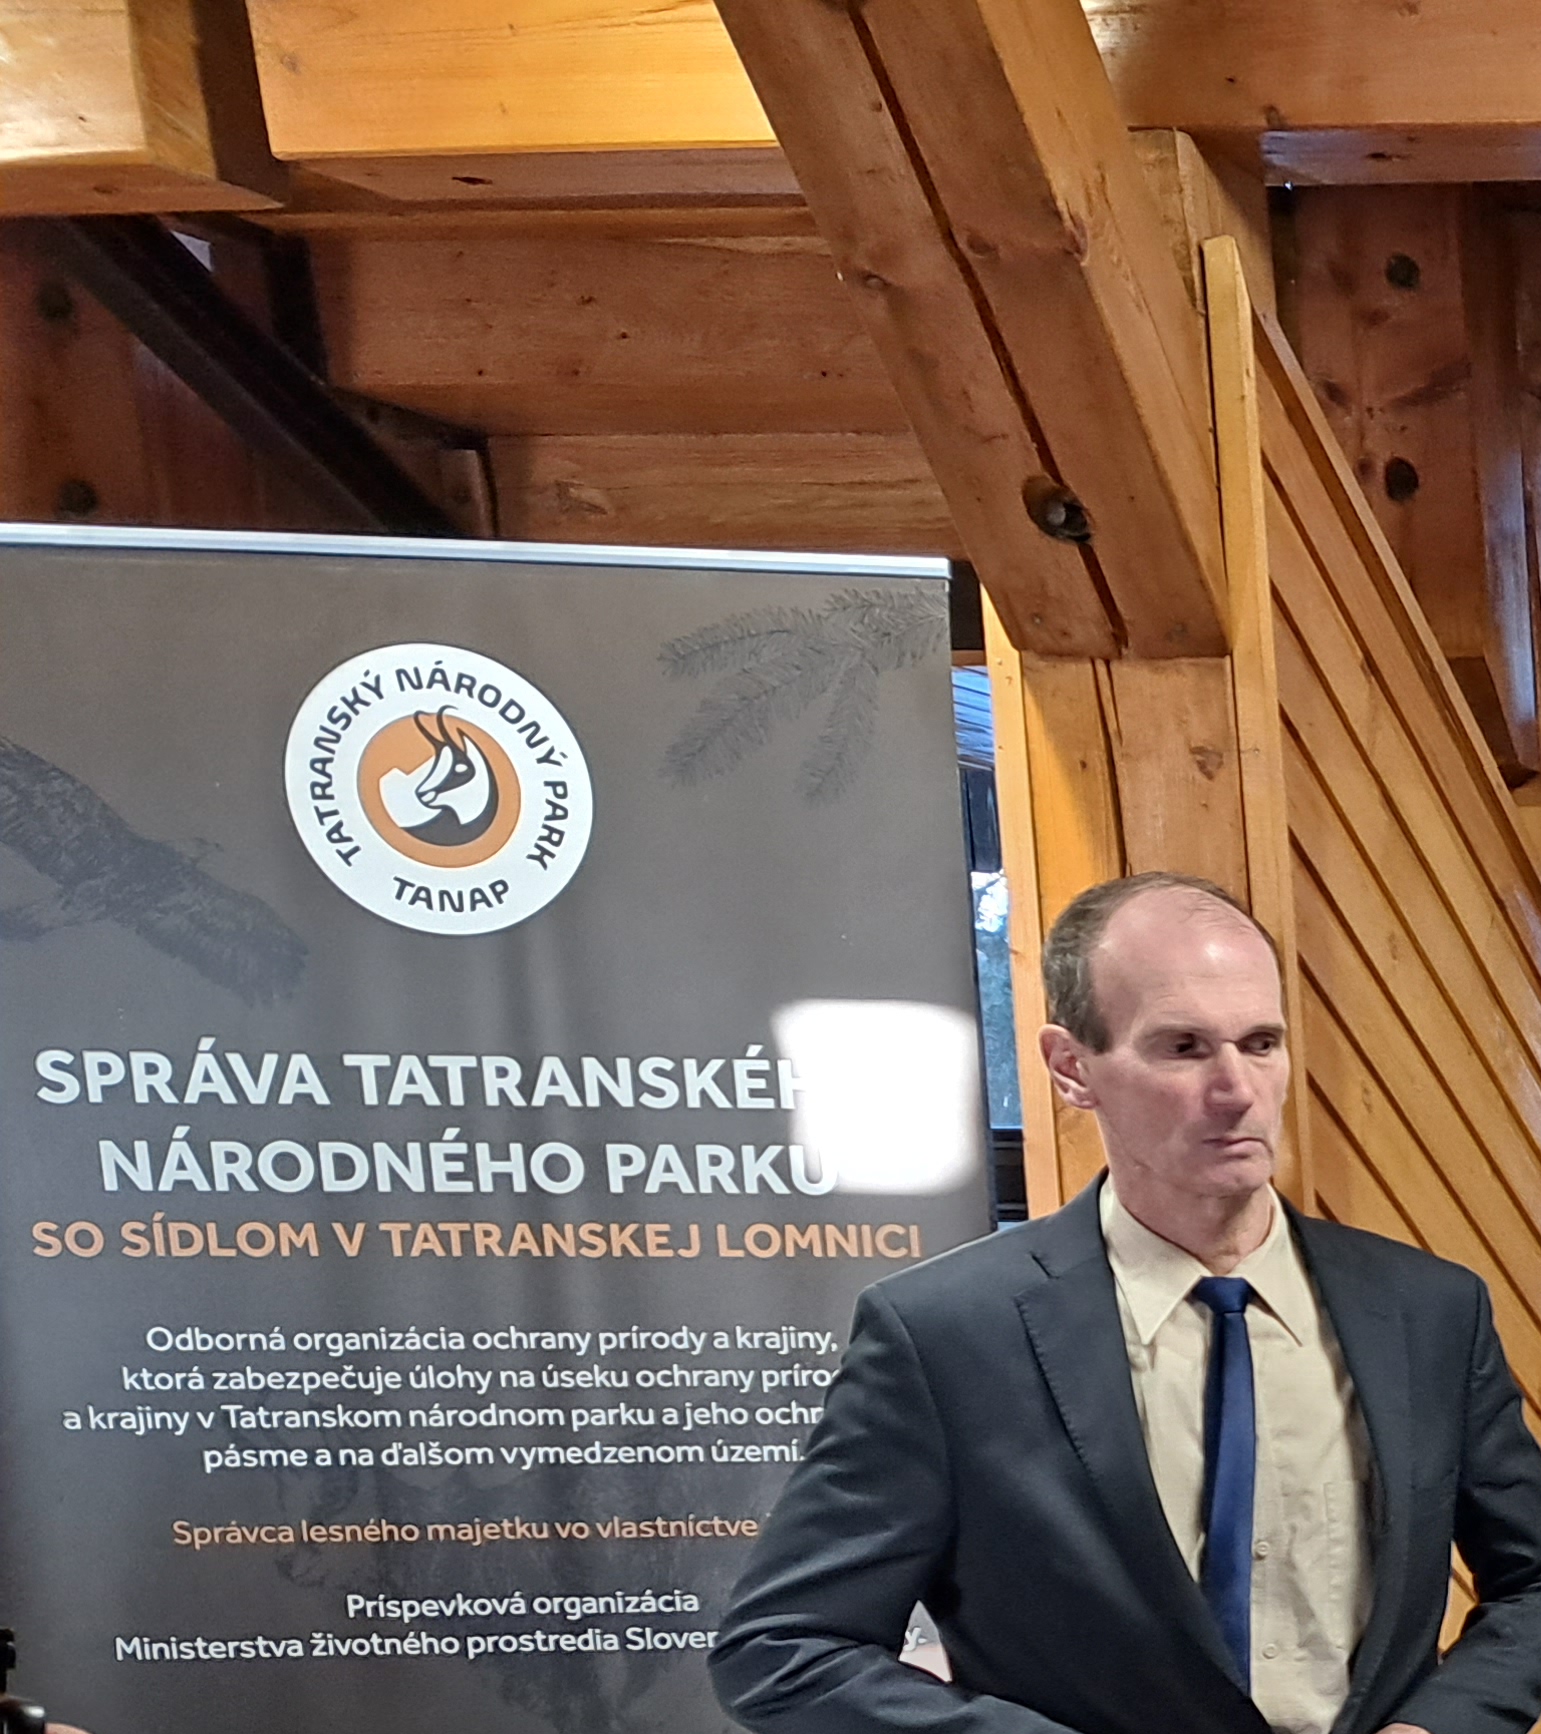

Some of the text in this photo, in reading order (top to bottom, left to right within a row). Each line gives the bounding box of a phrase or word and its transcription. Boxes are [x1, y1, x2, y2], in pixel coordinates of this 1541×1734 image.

[309, 660, 569, 869] TATRANSKÝ NÁRODNÝ PARK
[393, 877, 510, 912] TANAP
[35, 1038, 807, 1109] SPRÁVA TATRANSKÉH
[98, 1127, 838, 1196] NÁRODNÉHO PARKU
[31, 1209, 922, 1259] SO SÍDLOM V TATRANSKEJ LOMNICI
[146, 1325, 838, 1356] Odborná organizácia ochrany prírody a krajiny,
[122, 1364, 754, 1394] ktorá zabezpečuje úlohy na úseku ochrany
[62, 1403, 748, 1435] a krajiny v Tatranskom národnom parku a jeho
[204, 1438, 805, 1472] pásme a na ďalšom vymedzenom území.
[173, 1514, 758, 1550] Správca lesného majetku vo vlastníctve
[347, 1590, 699, 1623] Príspevková organizácia
[115, 1627, 619, 1661] Ministerstva životného prostredia
